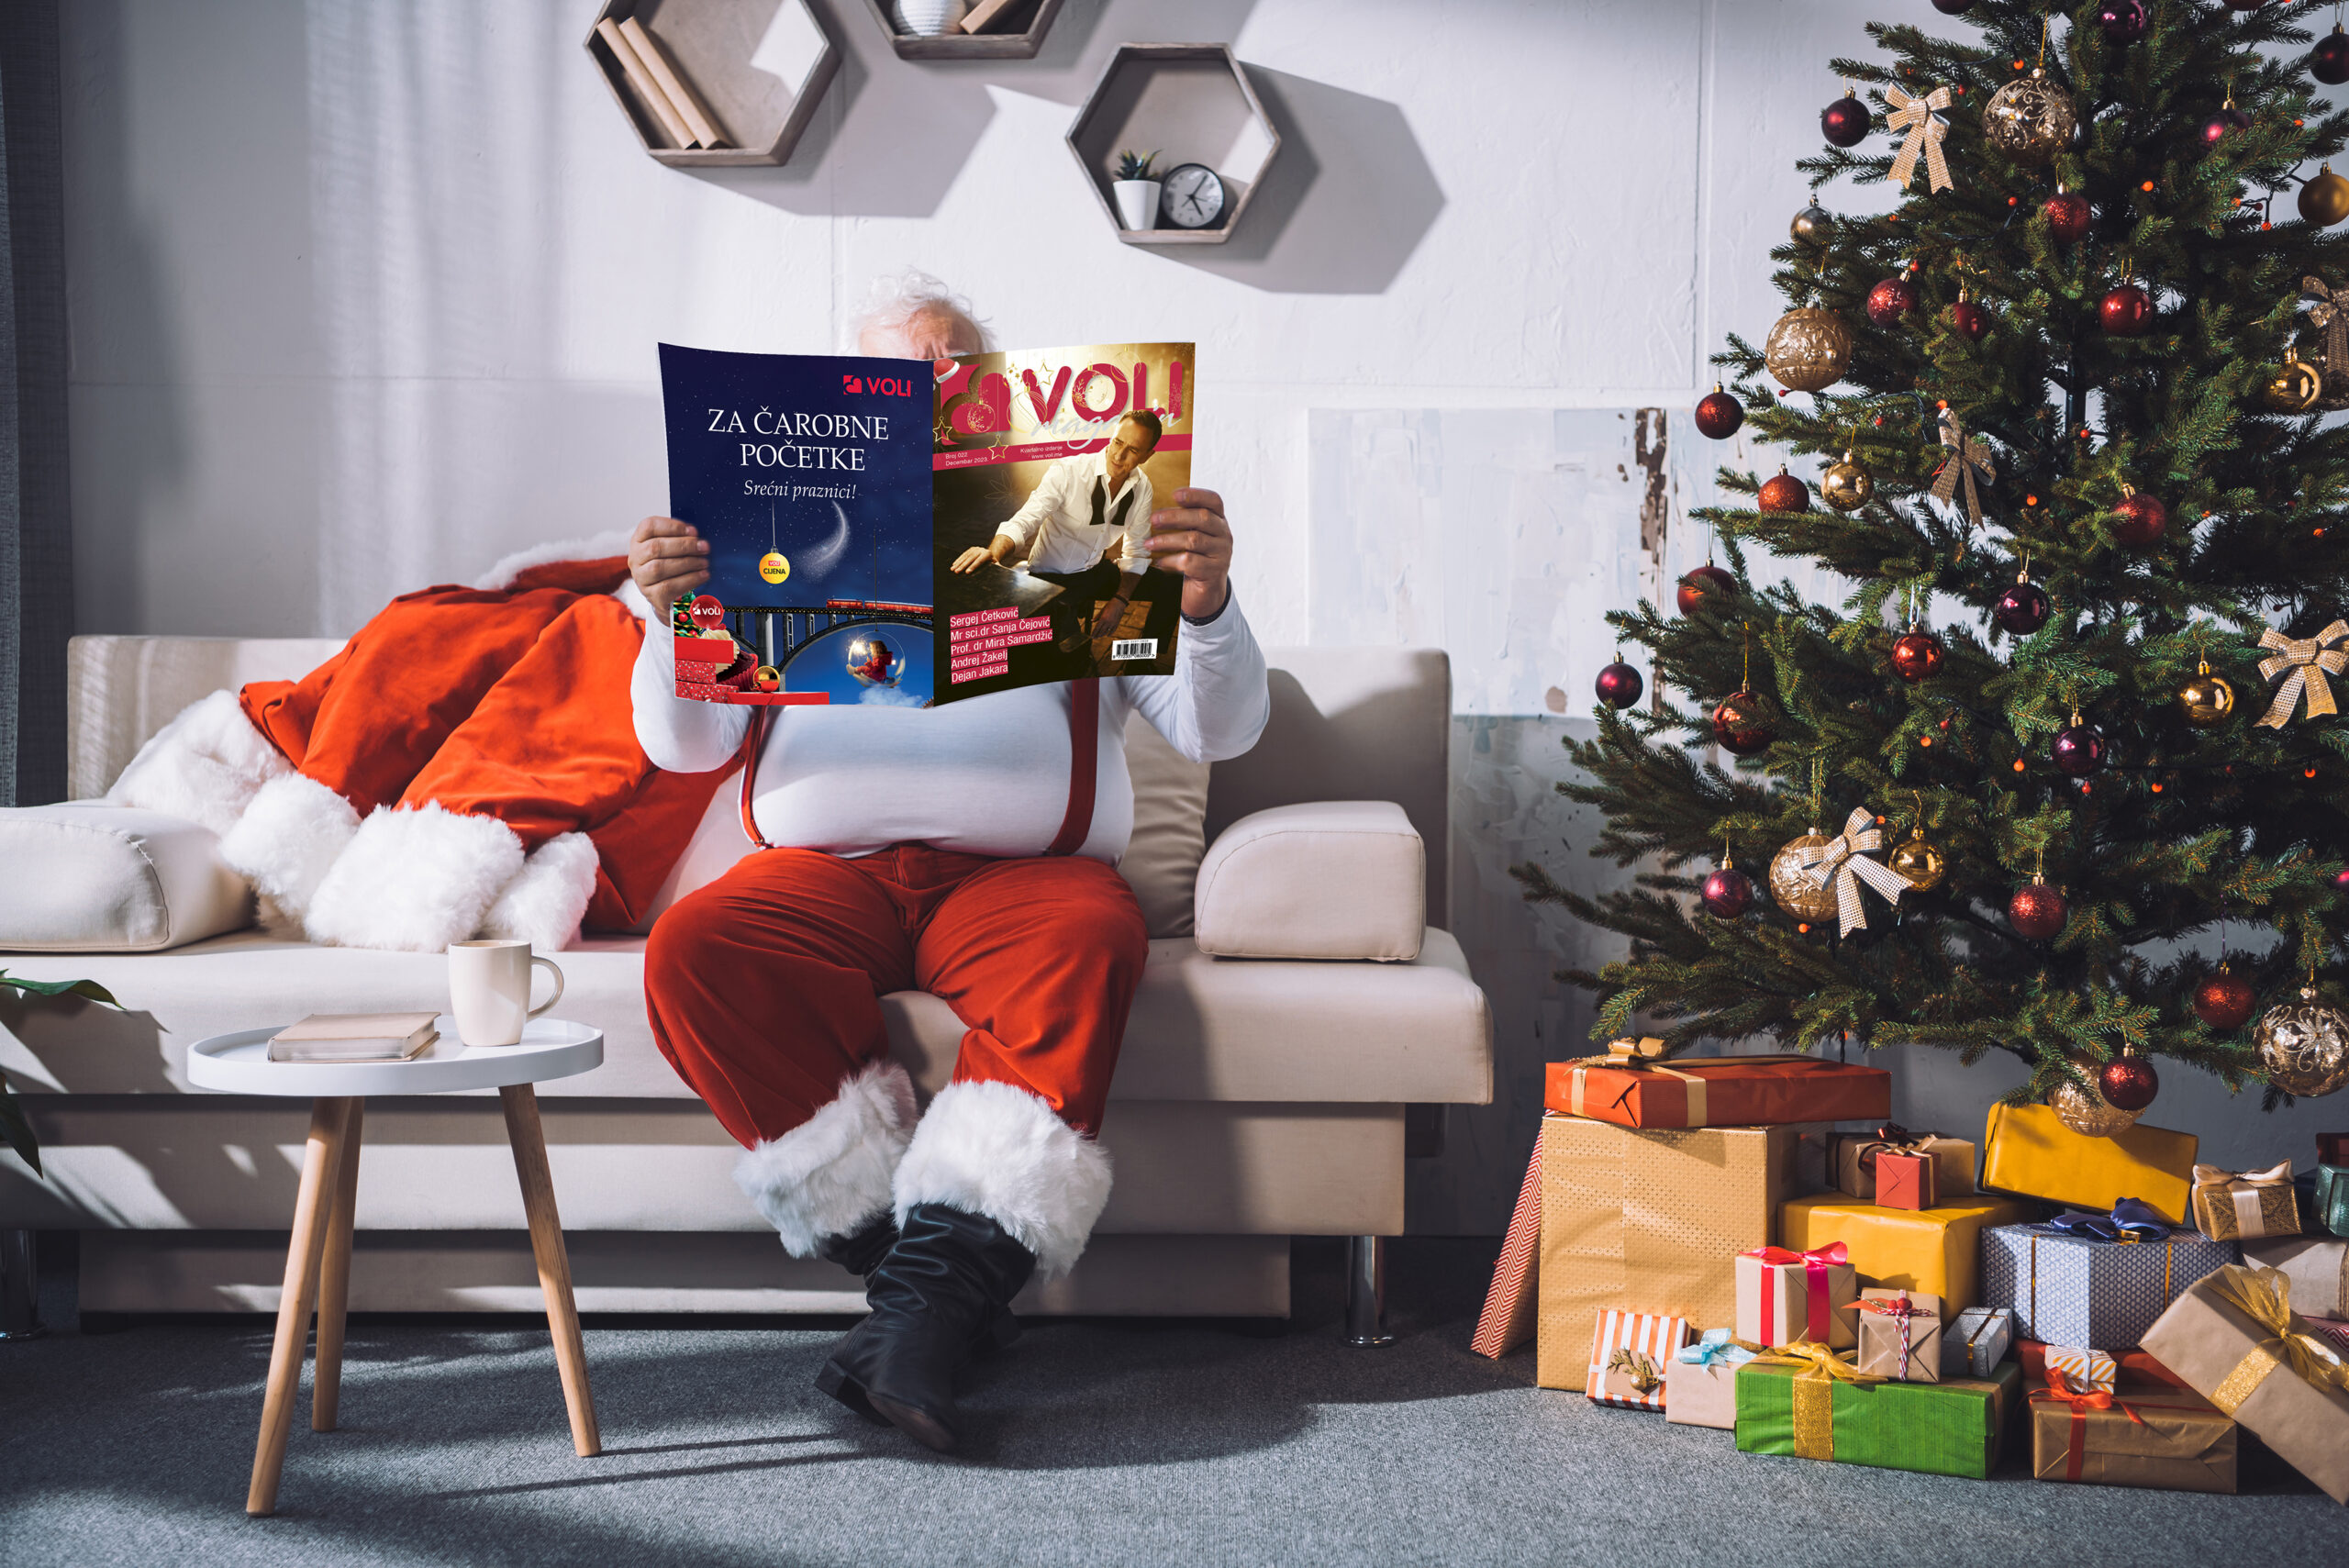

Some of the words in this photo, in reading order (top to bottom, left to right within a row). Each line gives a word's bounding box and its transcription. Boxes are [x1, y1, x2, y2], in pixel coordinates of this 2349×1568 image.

[867, 377, 911, 397] VOLI
[1022, 361, 1183, 425] VOLI
[707, 408, 747, 433] ZA
[753, 406, 889, 440] ČAROBNE
[740, 439, 865, 471] POČETKE
[744, 479, 788, 497] Srećni
[793, 484, 856, 501] praznici!
[702, 607, 720, 616] VOLI
[950, 613, 979, 627] Sergej
[951, 630, 963, 641] Mr
[992, 623, 1017, 634] Sanja
[1019, 617, 1050, 630] Čejović
[951, 642, 971, 655] Prof.
[974, 640, 983, 651] dr
[985, 638, 1005, 649] Mira
[1007, 628, 1052, 645] Samardžić
[951, 654, 979, 669] Andrej
[982, 650, 1008, 662] Žakelj
[952, 671, 976, 683] Dejan
[979, 664, 1008, 676] Jakara
